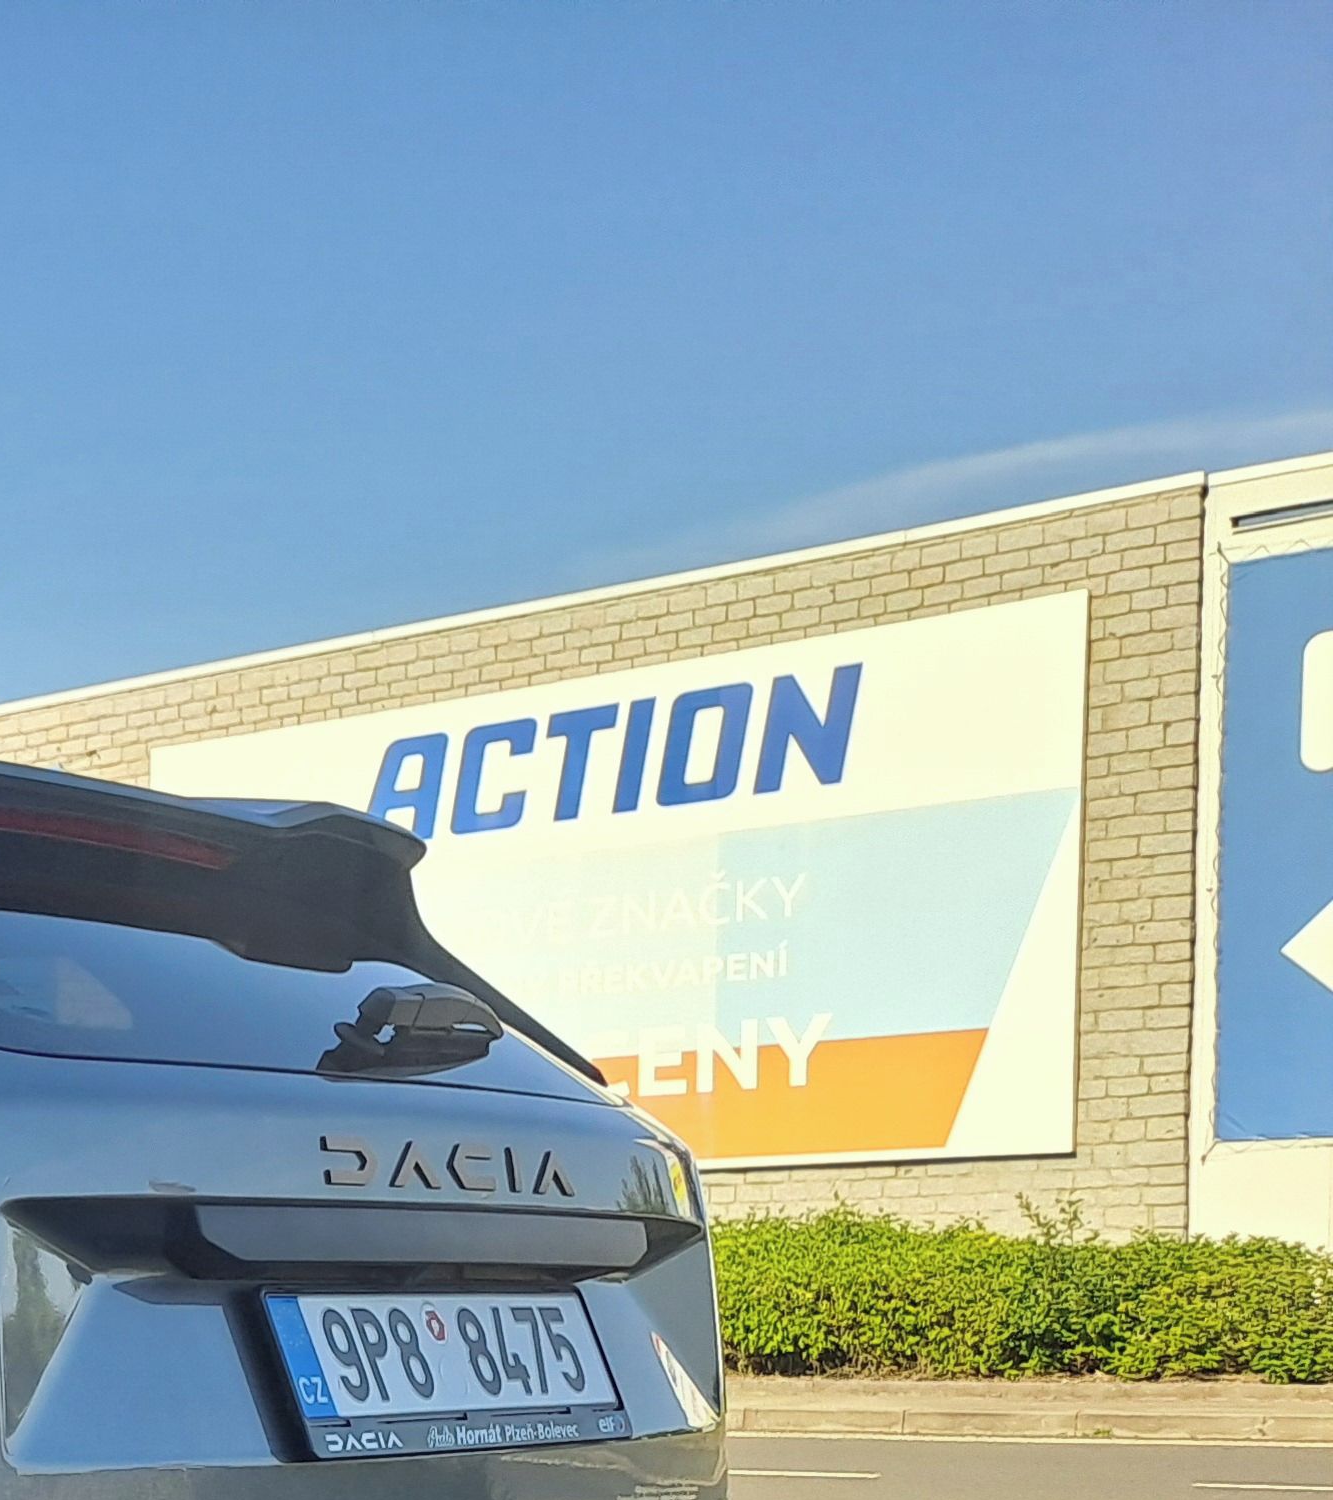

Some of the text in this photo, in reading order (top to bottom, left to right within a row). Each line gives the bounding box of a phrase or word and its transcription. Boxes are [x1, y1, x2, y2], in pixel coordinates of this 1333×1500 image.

[367, 661, 864, 840] ACTION
[585, 868, 807, 939] ZNAČKY
[319, 1134, 576, 1198] DACIA
[321, 1305, 587, 1402] 9P8 8475
[298, 1375, 329, 1406] CZ
[325, 1432, 404, 1452] DACIA
[455, 1421, 503, 1446] Hornát
[598, 1416, 615, 1433] elf
